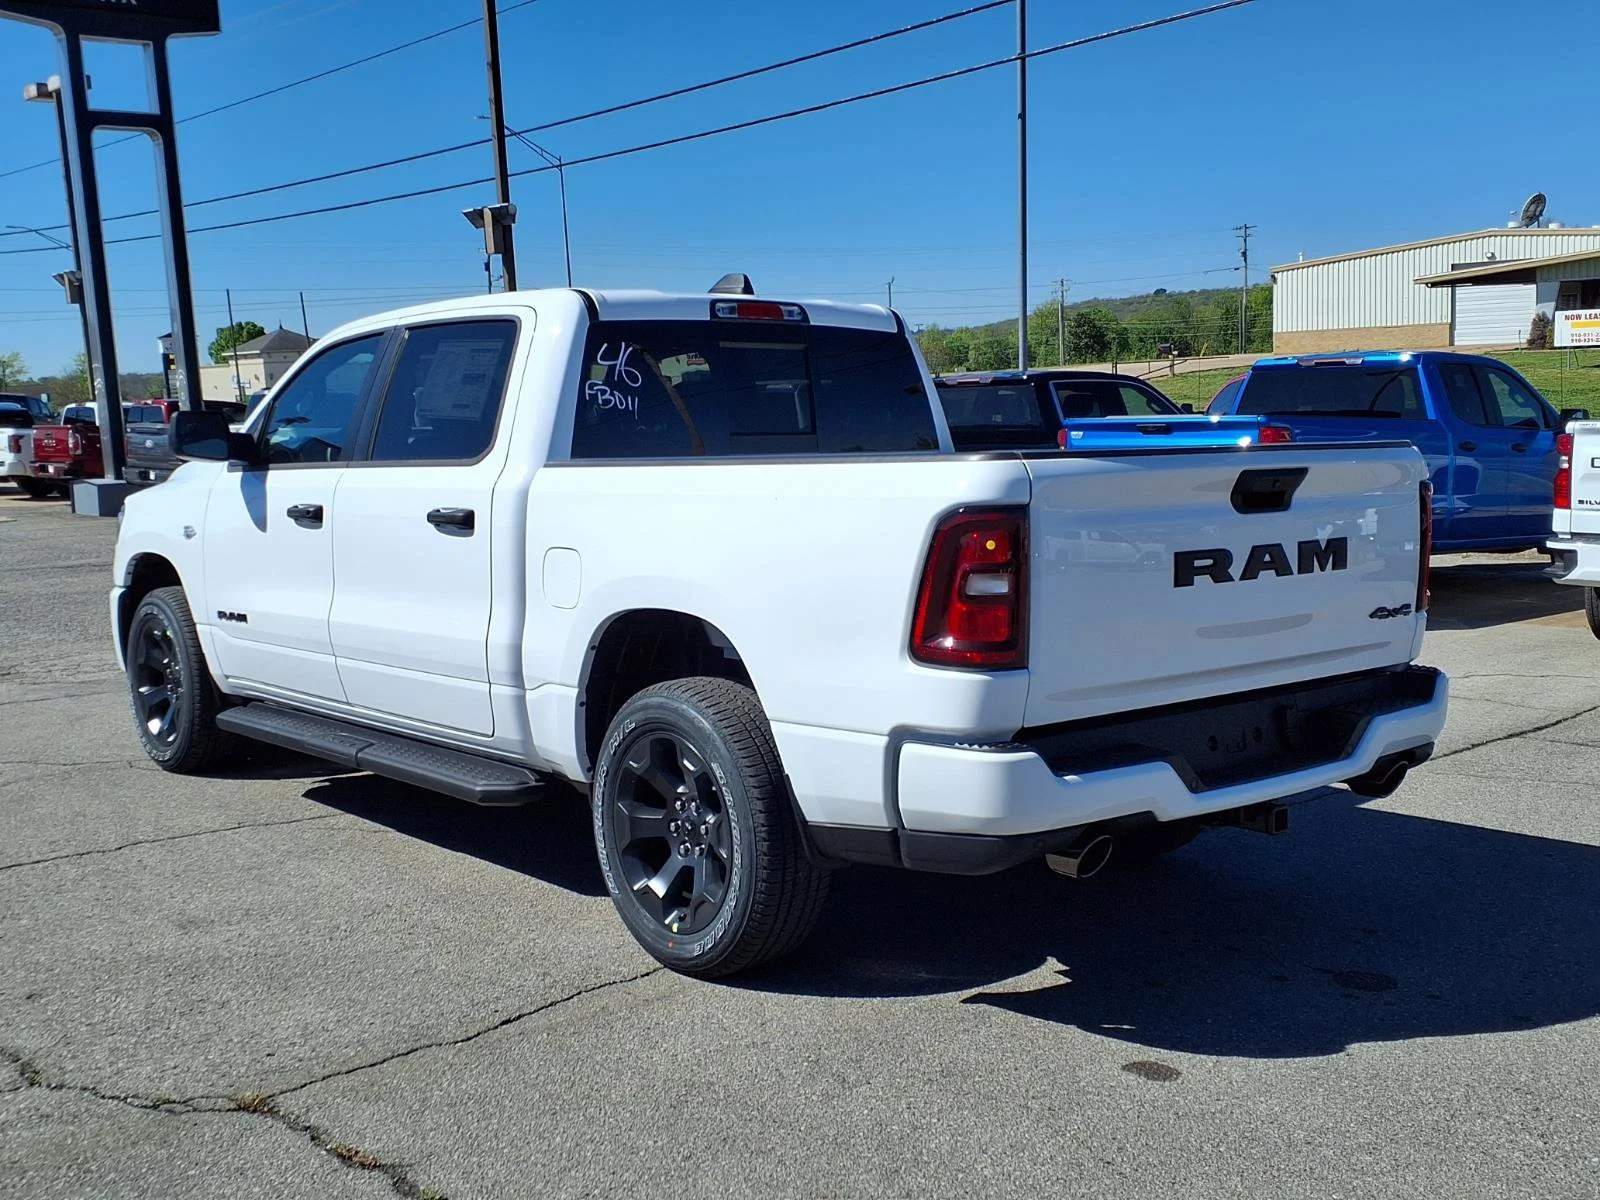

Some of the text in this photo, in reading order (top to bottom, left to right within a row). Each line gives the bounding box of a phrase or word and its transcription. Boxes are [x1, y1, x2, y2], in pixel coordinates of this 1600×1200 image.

[1565, 313, 1582, 321] NOW
[597, 342, 641, 387] 46
[1174, 536, 1348, 588] RAM
[217, 610, 248, 624] RAM
